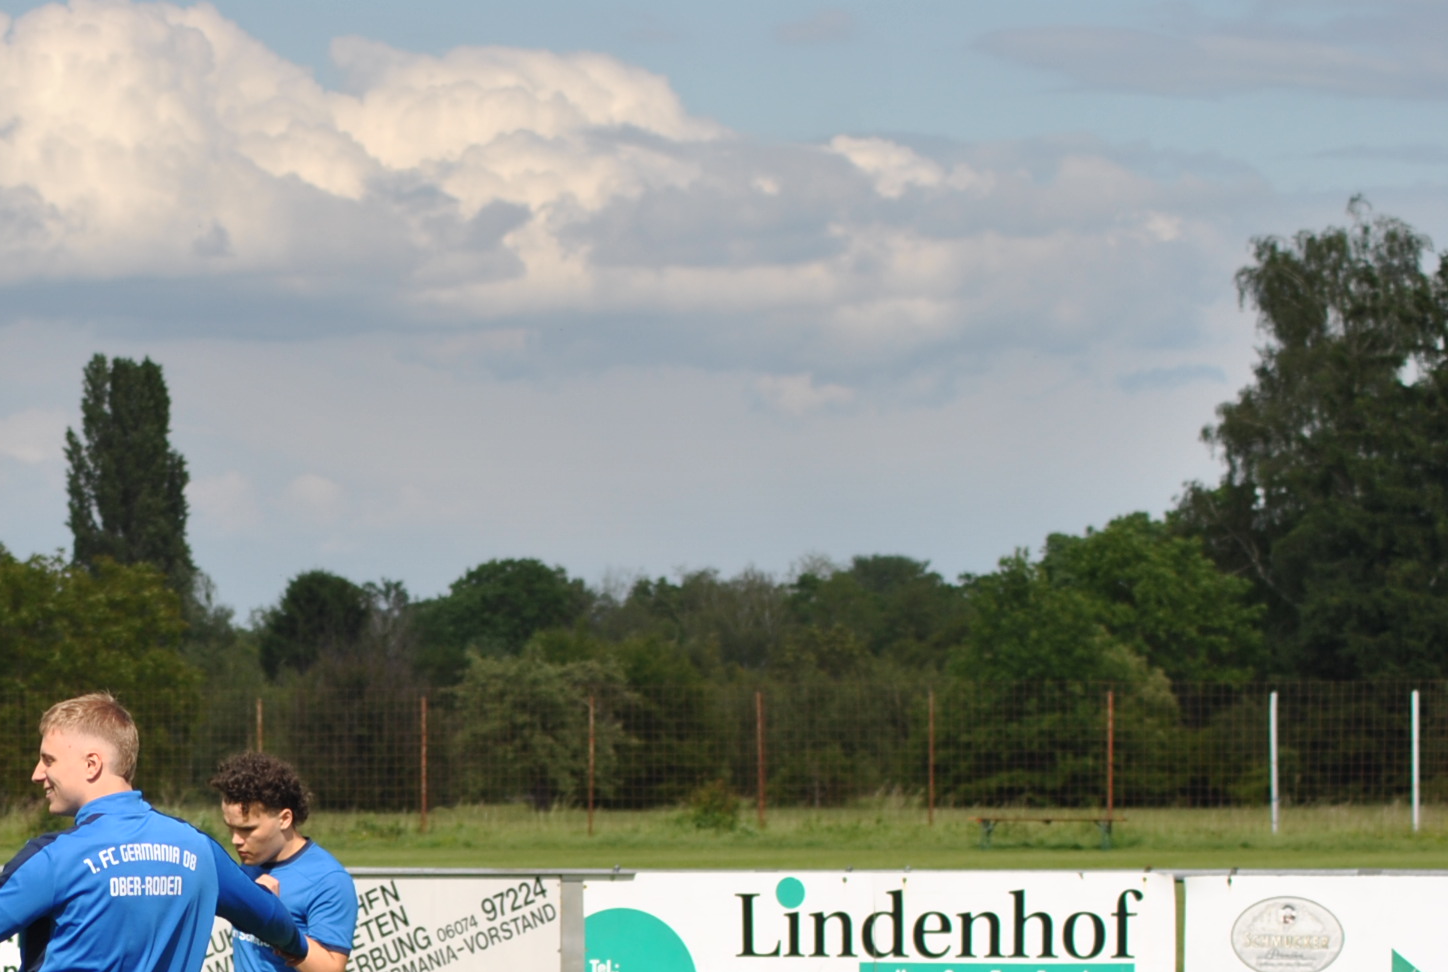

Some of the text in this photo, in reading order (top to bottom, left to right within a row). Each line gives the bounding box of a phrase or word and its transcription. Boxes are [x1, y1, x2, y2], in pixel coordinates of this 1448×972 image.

[83, 843, 197, 874] 1. FC GERMANIA 08
[110, 875, 182, 896] OBER-RODEN
[436, 914, 478, 942] 06074
[481, 876, 547, 922] 97224
[734, 877, 1143, 960] Lindenhof
